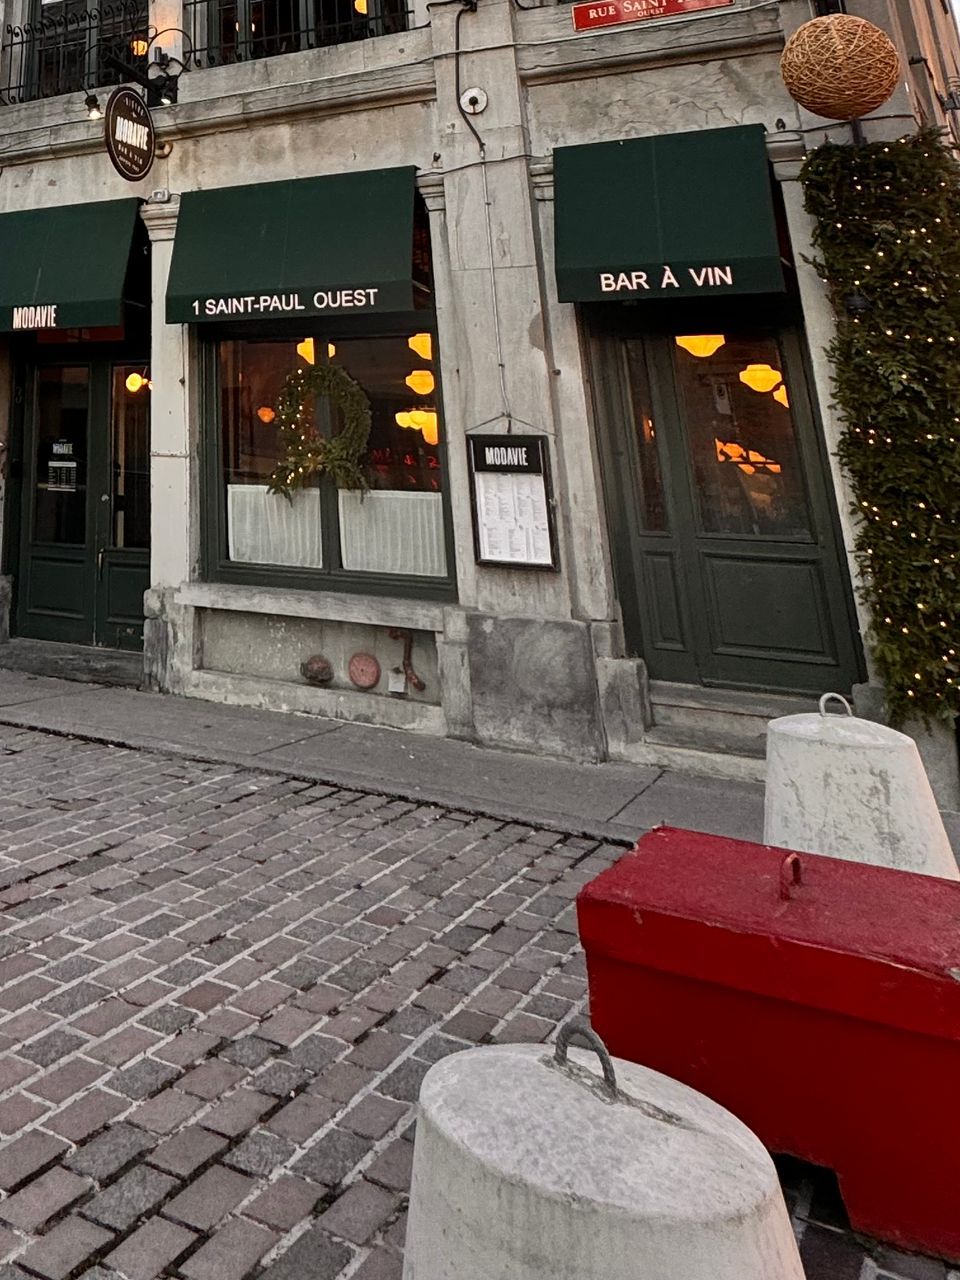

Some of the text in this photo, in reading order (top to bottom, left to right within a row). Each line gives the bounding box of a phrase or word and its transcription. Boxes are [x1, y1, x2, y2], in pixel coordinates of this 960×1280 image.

[588, 5, 616, 19] RUE
[637, 7, 665, 18] OUEST
[115, 116, 149, 151] MODAVIE
[599, 265, 733, 292] BAR À VIN
[192, 288, 379, 316] 1 SAINT-PAUL OUEST
[12, 305, 57, 329] MODAVIE
[485, 447, 528, 466] MODAVIE
